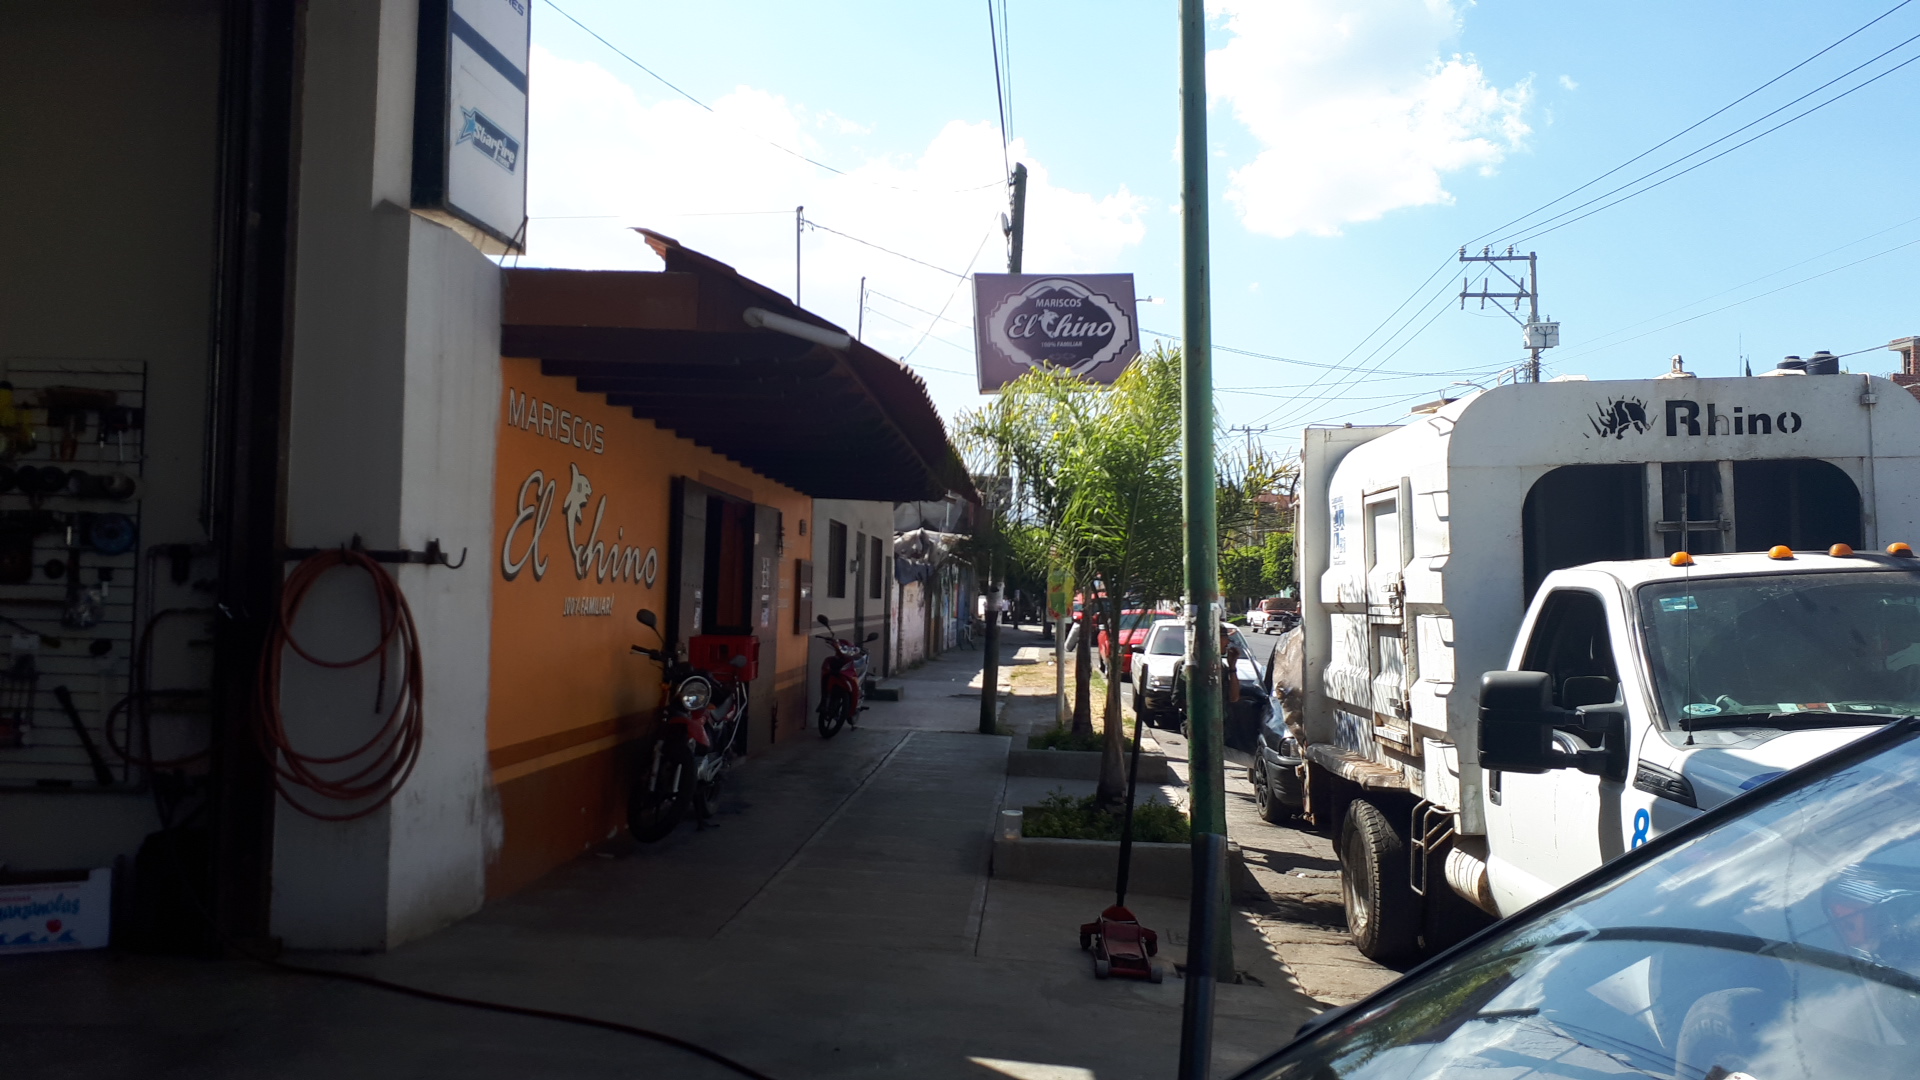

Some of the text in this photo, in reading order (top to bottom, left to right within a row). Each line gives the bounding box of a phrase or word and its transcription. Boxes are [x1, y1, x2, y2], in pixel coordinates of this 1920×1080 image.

[474, 122, 515, 164] Starfire
[1035, 299, 1082, 308] MARISCOS
[1008, 313, 1041, 339] El
[508, 387, 604, 454] MARISCOS
[1665, 400, 1802, 436] Rhino
[502, 469, 556, 581] El
